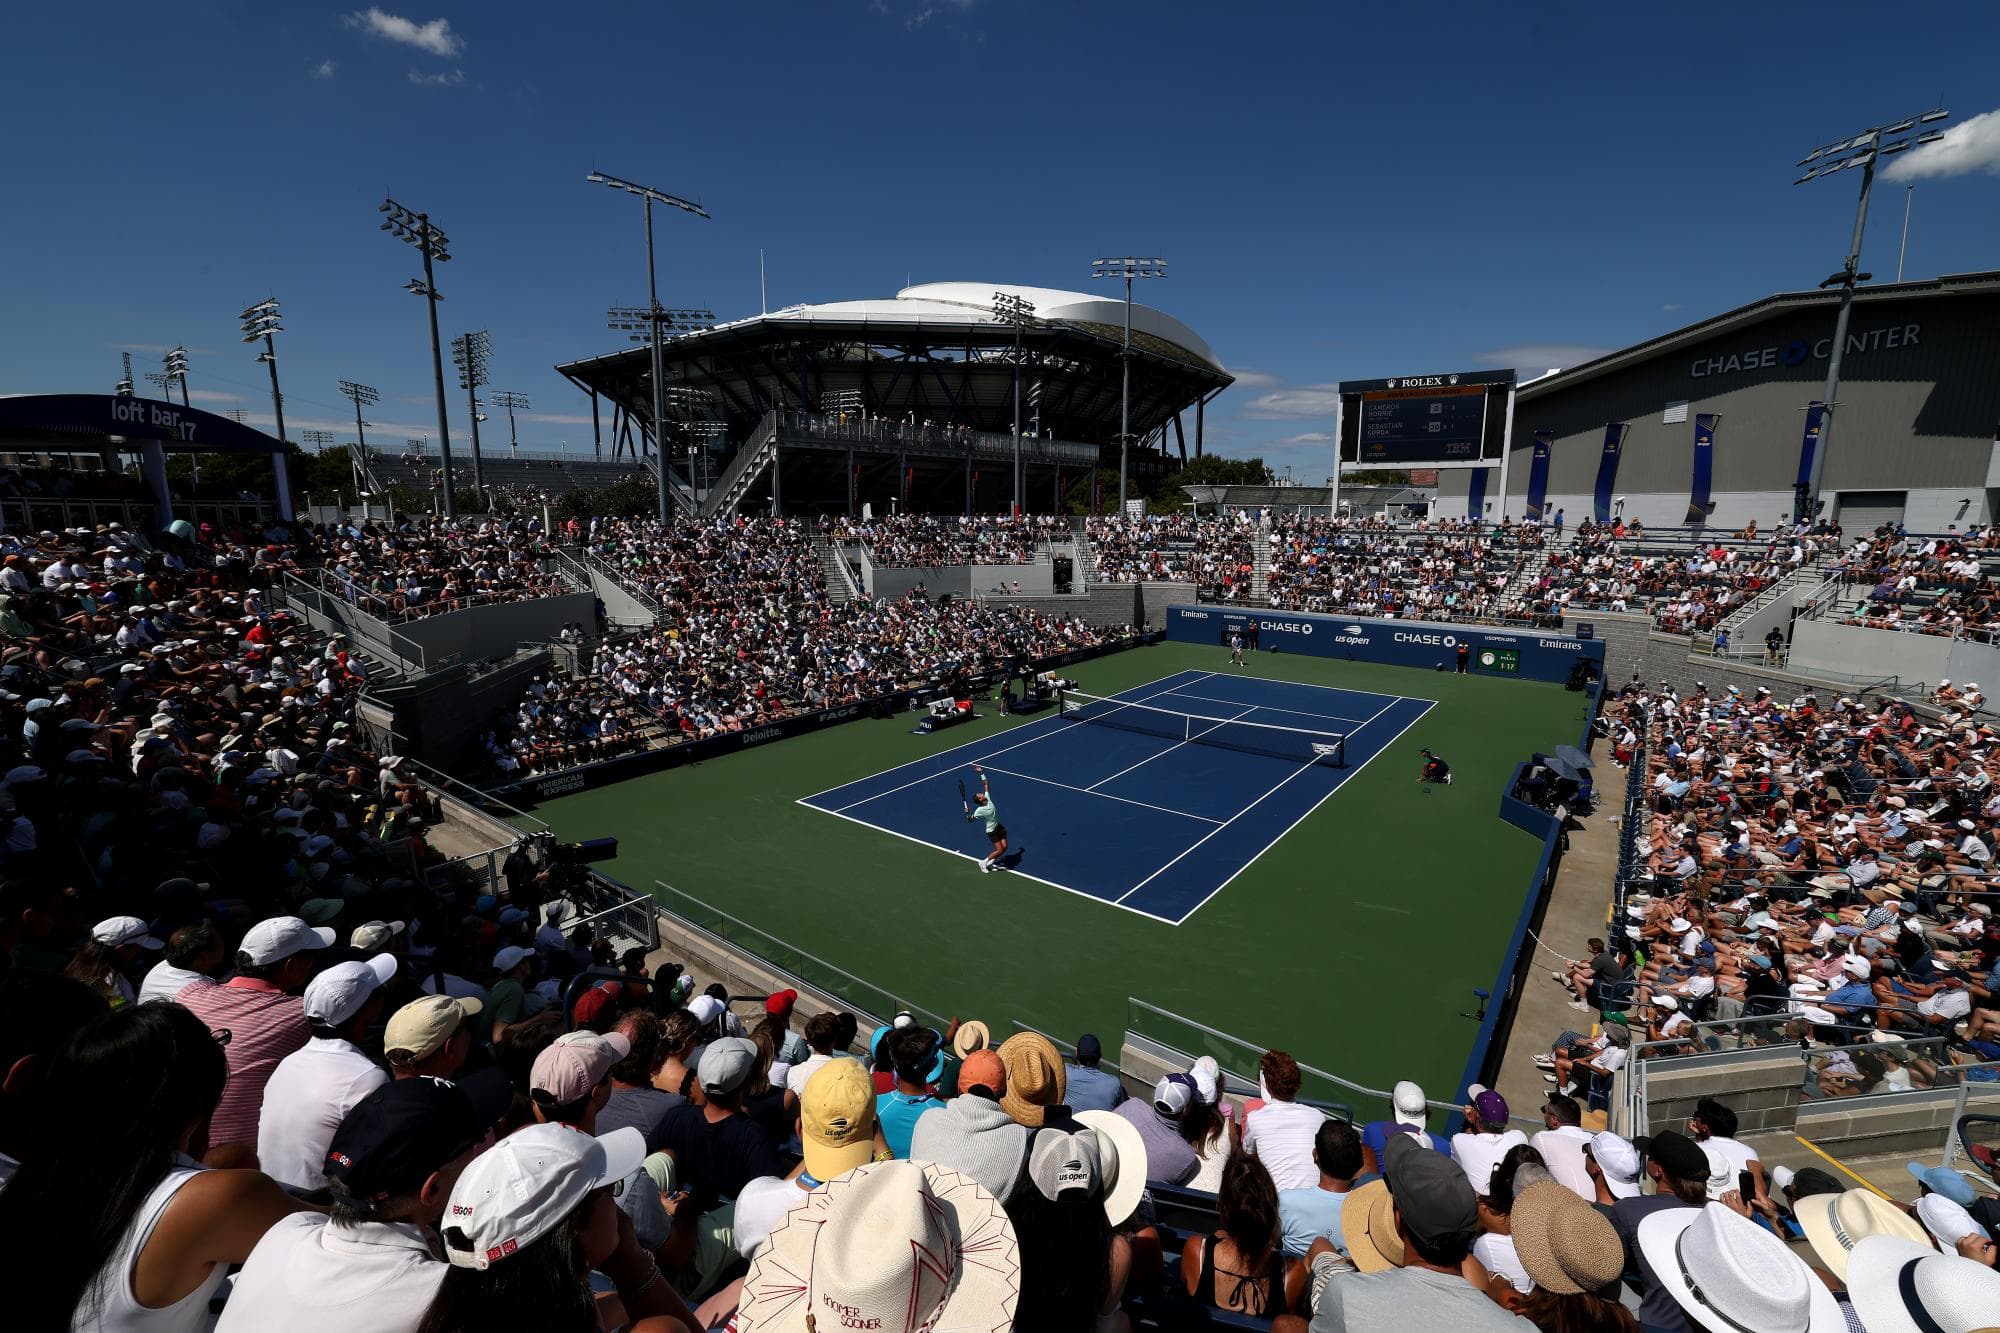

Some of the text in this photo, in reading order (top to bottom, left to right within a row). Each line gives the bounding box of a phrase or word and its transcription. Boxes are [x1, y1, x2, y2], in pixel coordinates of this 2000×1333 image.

[1690, 324, 1921, 377] CHASE CNTER
[1402, 376, 1443, 388] ROLEX
[111, 399, 181, 427] loft bar
[1446, 442, 1472, 455] IBM
[1181, 610, 1209, 619] Emirates
[1261, 621, 1300, 633] CHASE
[1346, 636, 1370, 645] open
[1394, 632, 1441, 645] CHASE
[1539, 639, 1582, 650] Emirates
[536, 772, 584, 792] AMERICAN
[543, 780, 585, 796] EXPRESS
[834, 1126, 852, 1138] open
[1068, 1173, 1087, 1182] open
[823, 1293, 860, 1318] BOOMER
[840, 1314, 881, 1330] SOONER
